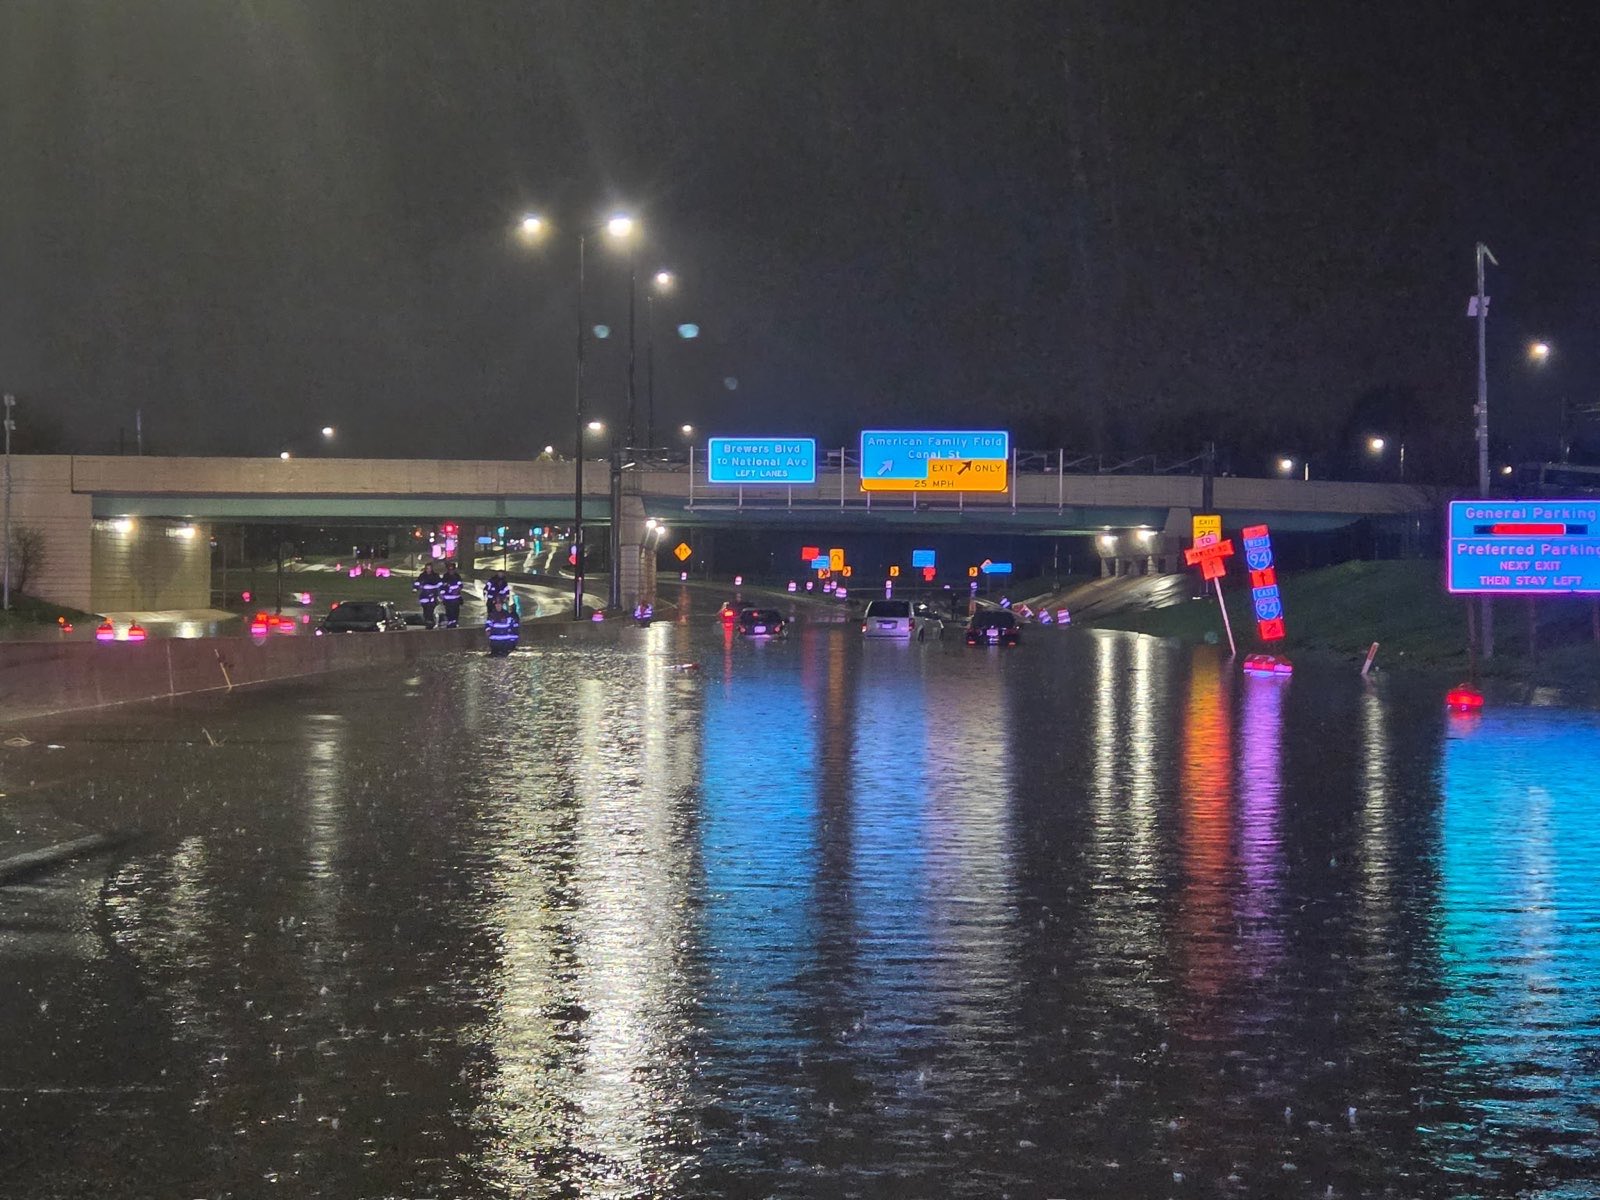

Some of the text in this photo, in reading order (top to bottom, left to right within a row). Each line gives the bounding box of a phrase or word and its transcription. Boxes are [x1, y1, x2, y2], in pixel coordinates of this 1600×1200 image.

[868, 437, 1002, 448] American Family Field
[724, 444, 800, 454] Brewers Blvd
[908, 449, 961, 459] Canal St
[731, 457, 780, 466] National
[786, 457, 807, 466] Ave
[932, 464, 1002, 473] EXIT ONLY
[914, 480, 927, 488] 25
[1465, 507, 1597, 521] General Parking
[1248, 539, 1267, 547] WEST
[1457, 543, 1534, 556] Preferred
[1250, 552, 1269, 565] 94
[1499, 561, 1561, 571] NEXT EXIT
[1479, 576, 1582, 586] THEN STAY LEFT
[1257, 588, 1275, 597] EAST
[1259, 604, 1277, 616] 94
